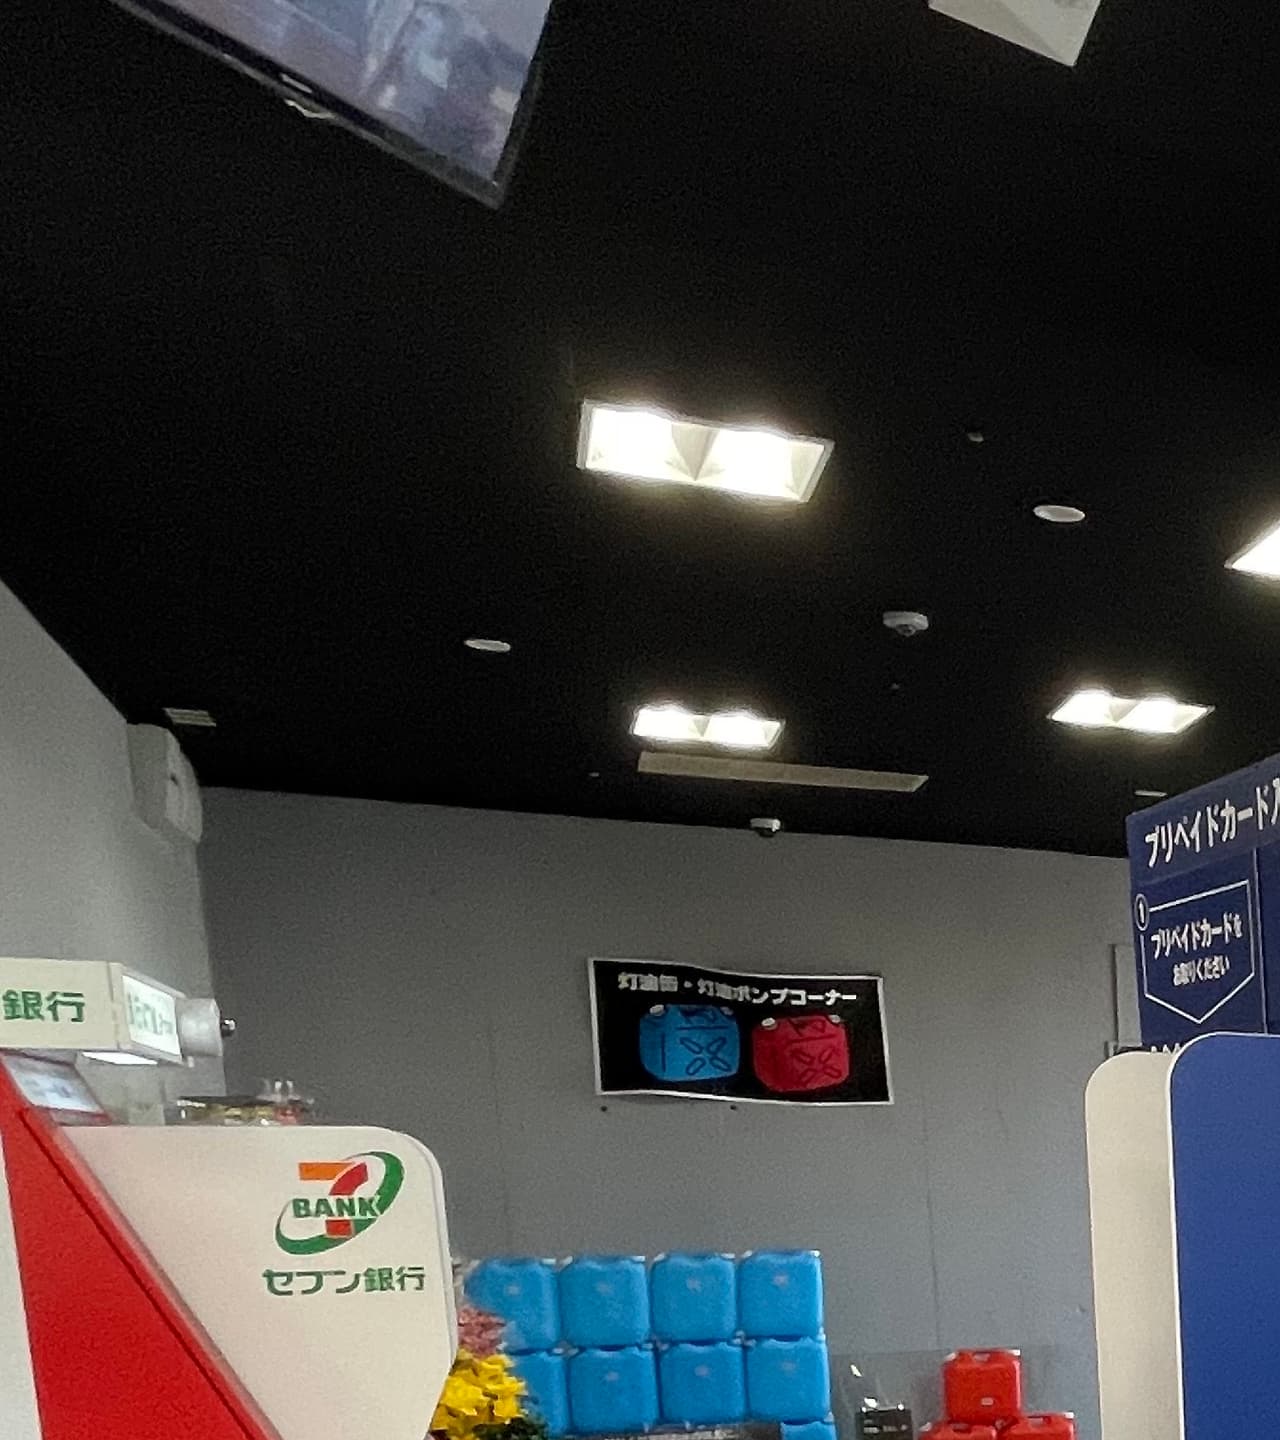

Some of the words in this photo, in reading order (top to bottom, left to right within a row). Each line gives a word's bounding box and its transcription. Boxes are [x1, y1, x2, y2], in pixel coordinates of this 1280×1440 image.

[1151, 912, 1243, 960] プリペイドカードを
[2, 989, 85, 1022] 銀行
[292, 1196, 382, 1219] BANK
[262, 1265, 425, 1296] セブン銀行
